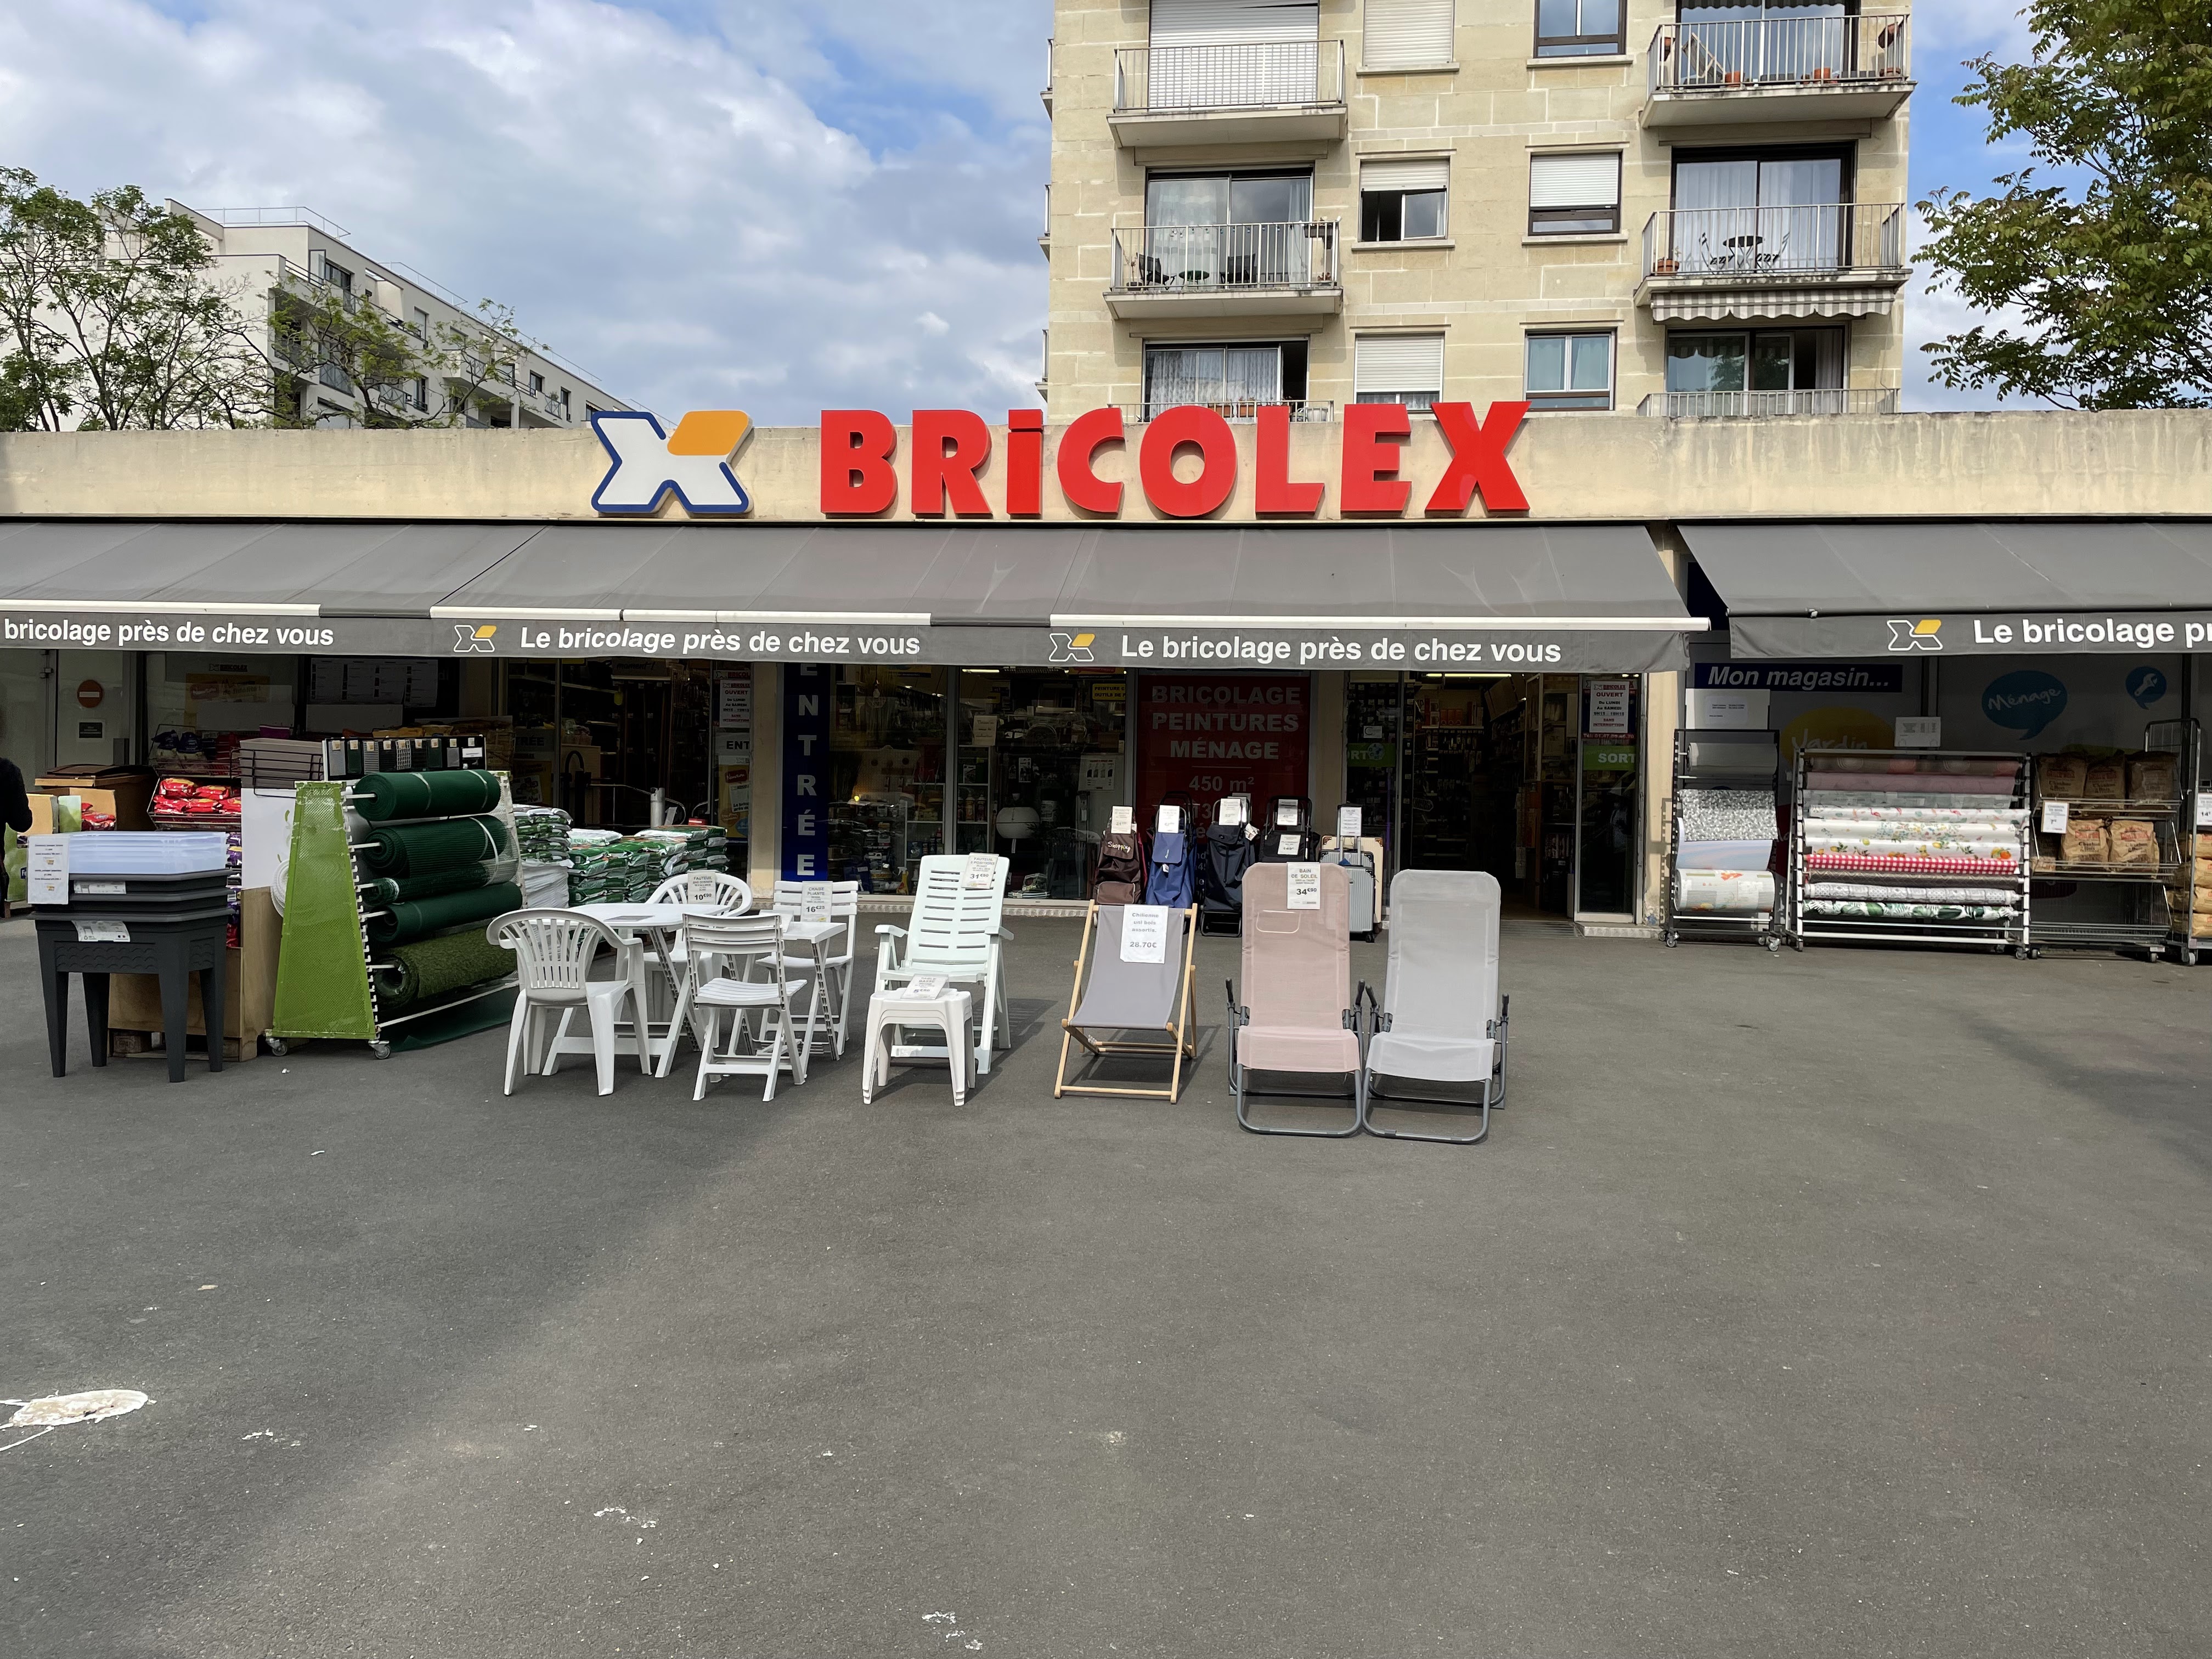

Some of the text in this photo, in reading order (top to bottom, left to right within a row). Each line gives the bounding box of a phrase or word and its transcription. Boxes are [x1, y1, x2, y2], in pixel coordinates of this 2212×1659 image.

[5, 619, 334, 646] bricolage près de chez vous
[521, 627, 920, 654] Le bricolage près de chez vous
[1974, 619, 2013, 644] Le
[2022, 618, 2175, 648] bricolage
[1121, 635, 1561, 664] Le bricolage près de chez vous
[1708, 666, 1889, 691] Mon magasin...
[1152, 686, 1301, 704] BRICOLAGE
[1987, 687, 2062, 711] Ménage
[1152, 712, 1299, 732] PEINTURES
[726, 741, 750, 749] ENT
[1170, 737, 1279, 760] MÉNAGE
[1189, 775, 1222, 792] 450
[1108, 841, 1131, 853] Shopping
